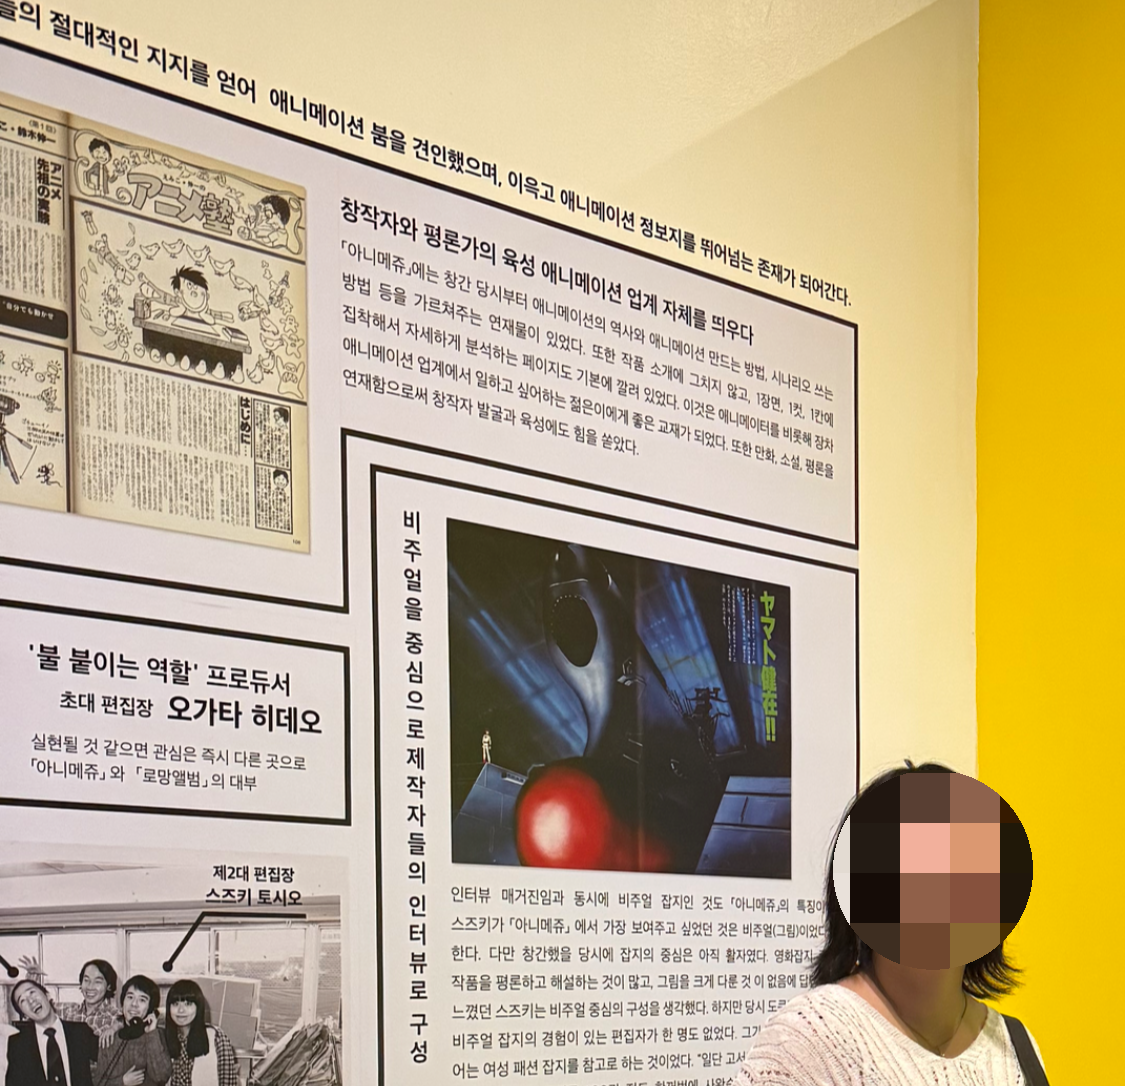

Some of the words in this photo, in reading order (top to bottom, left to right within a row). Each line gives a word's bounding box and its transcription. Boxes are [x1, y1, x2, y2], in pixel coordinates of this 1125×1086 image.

[49, 9, 139, 63] 절대적인
[146, 44, 210, 87] 지지를
[216, 69, 256, 104] 얻어
[269, 88, 364, 140] 애니메이션
[370, 121, 407, 155] 붐을
[412, 136, 502, 188] 견인했으며,
[507, 170, 555, 203] 이윽고
[560, 188, 635, 232] 애니메이션
[639, 216, 696, 254] 정보지를
[700, 237, 754, 273] 뛰어넘는
[757, 257, 796, 288] 존재가
[799, 273, 851, 307] 되어간다.
[340, 196, 418, 242] 창작자와
[423, 222, 496, 266] 평론가의
[501, 247, 535, 277] 육성
[541, 260, 622, 305] 애니메이션
[626, 287, 657, 316] 업계
[662, 298, 707, 331] 자체를
[711, 314, 754, 346] 띄우다
[443, 269, 472, 293] 창간
[476, 279, 528, 310] 당시부터
[531, 296, 606, 334] 애니메이션의
[609, 319, 645, 345] 역사와
[648, 332, 704, 363] 애니메이션
[708, 349, 741, 374] 만드는
[743, 360, 768, 382] 방법,
[770, 369, 811, 394] 시나리오
[813, 383, 833, 402] 쓰는
[342, 303, 400, 336] 집착해서
[404, 321, 461, 352] 자세하게
[465, 336, 518, 367] 분석하는
[522, 353, 573, 381] 페이지도
[576, 368, 612, 393] 기본에
[616, 378, 639, 400] 깔려
[643, 386, 680, 410] 있었다.
[683, 397, 715, 421] 이것은
[717, 408, 780, 439] 애니메이터를
[782, 426, 812, 448] 비롯해
[814, 434, 834, 453] 장차
[342, 368, 428, 405] 연재함으로써
[432, 389, 473, 415] 창작자
[477, 400, 516, 426] 발굴과
[519, 411, 570, 438] 육성에도
[573, 424, 598, 447] 힘을
[601, 432, 639, 456] 쏟았다.
[403, 510, 424, 622] 비주얼을
[29, 643, 61, 671] '불
[68, 647, 139, 680] 붙이는
[146, 657, 198, 686] 역할'
[206, 664, 290, 697] 프로듀서
[59, 690, 95, 713] 초대
[100, 695, 153, 718] 편집장
[167, 695, 243, 729] 오가타
[250, 703, 322, 735] 히데오
[31, 732, 78, 754] 실현될
[83, 737, 98, 755] 것
[103, 739, 148, 759] 같으면
[152, 743, 197, 763] 관심은
[201, 747, 229, 766] 즉시
[233, 750, 261, 768] 다른
[265, 753, 306, 770] 곳으로
[229, 774, 257, 792] 대부
[204, 887, 251, 906] 스즈키
[256, 888, 303, 907] 토시오
[212, 864, 249, 882] 제2대
[253, 865, 295, 883] 편집장
[450, 885, 491, 904] 인터뷰
[501, 887, 564, 906] 매거진임과
[573, 890, 609, 908] 동시에
[618, 892, 652, 909] 비주얼
[660, 893, 693, 910] 잡지인
[702, 895, 723, 911] 것도
[407, 894, 428, 1000] 인터뷰로
[408, 1013, 429, 1064] 구성
